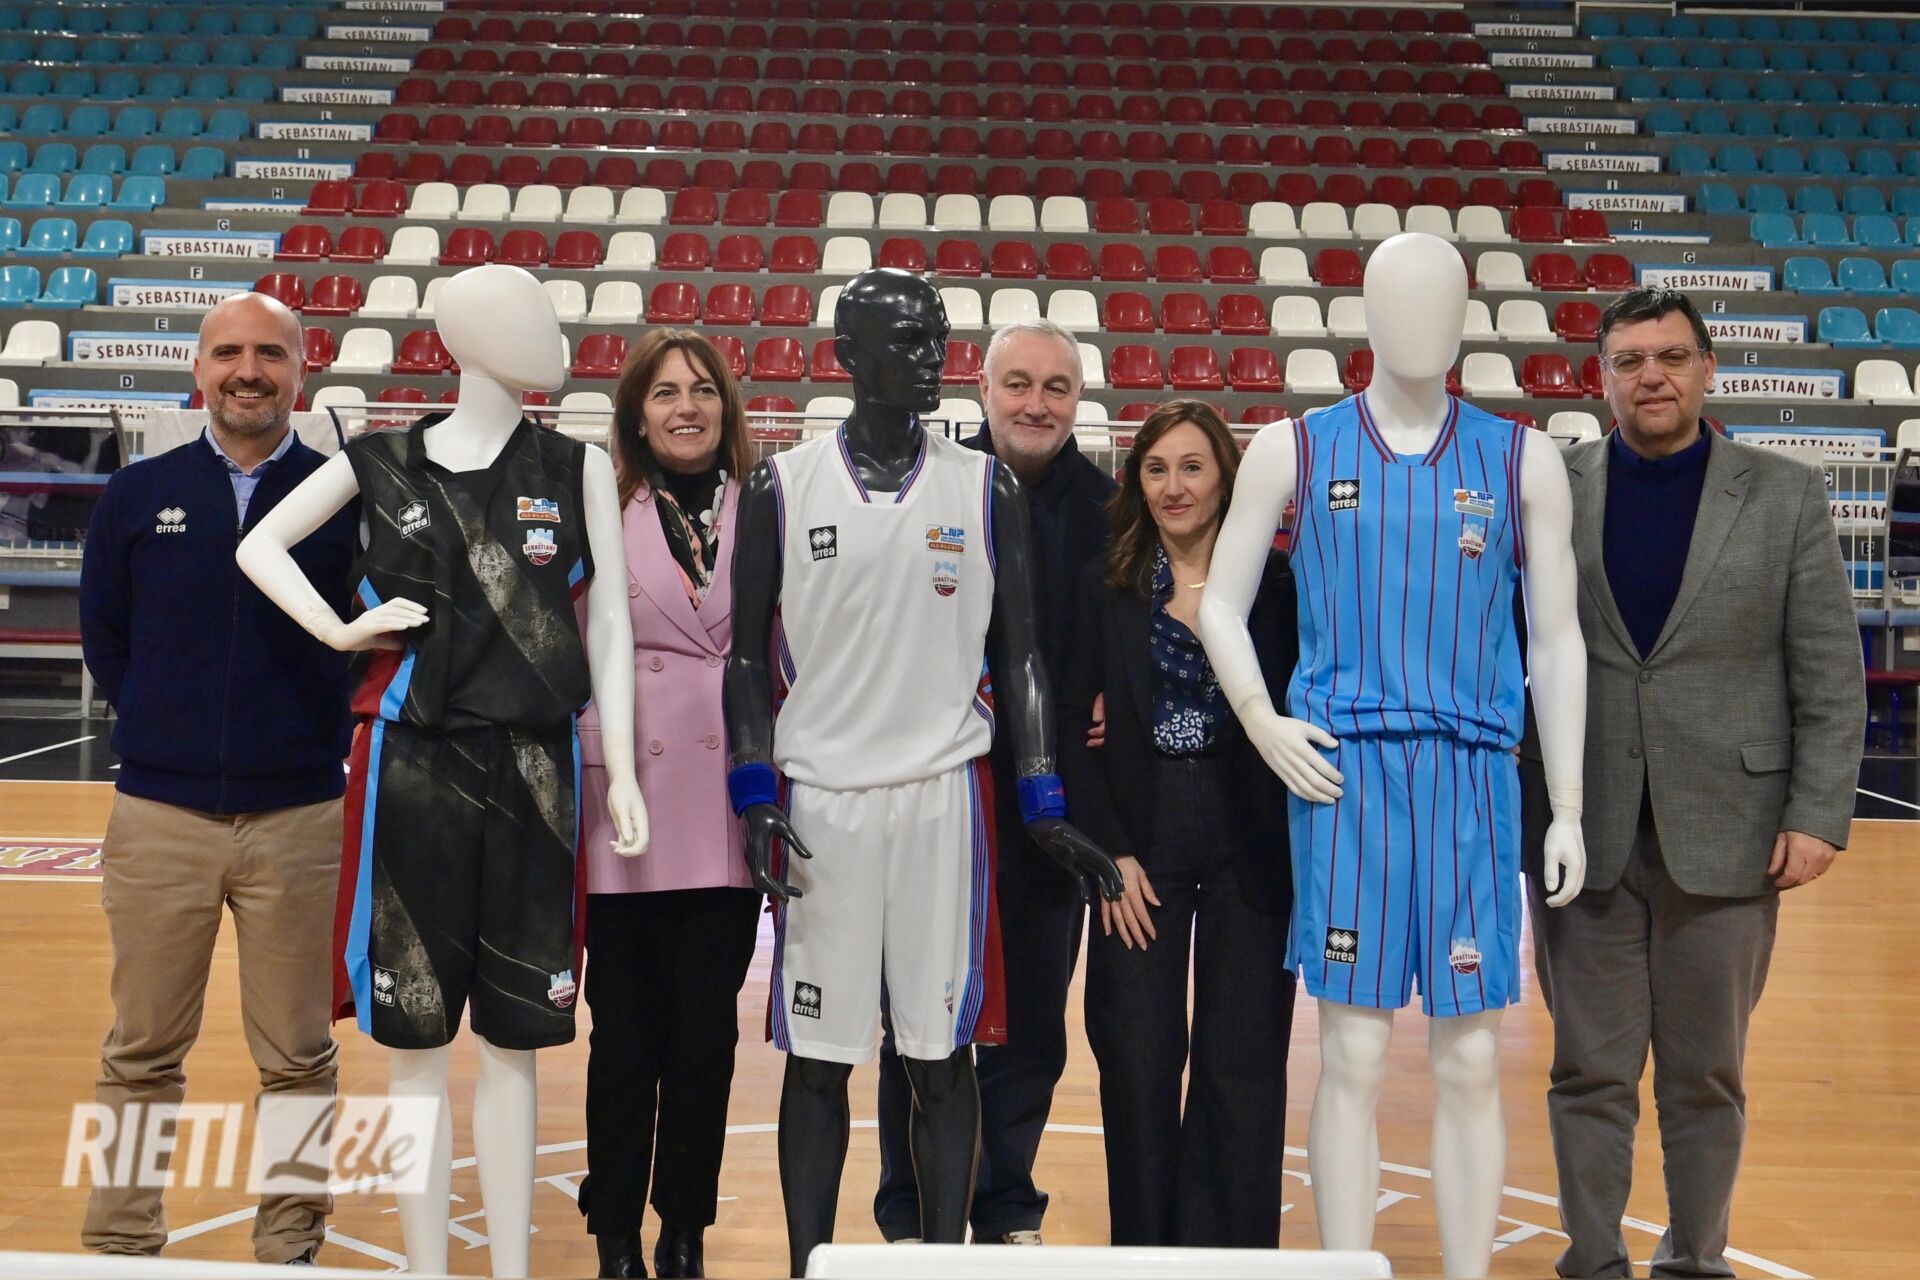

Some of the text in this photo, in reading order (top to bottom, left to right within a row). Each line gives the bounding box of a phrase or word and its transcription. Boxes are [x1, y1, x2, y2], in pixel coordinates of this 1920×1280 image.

[345, 30, 411, 40] SEBASTIANI
[323, 60, 392, 72] SEBASTIANI
[301, 92, 372, 104] SEBASTIANI
[1527, 89, 1596, 100] SEBASTIANI
[278, 127, 352, 140] SEBASTIANI
[1546, 122, 1617, 134] SEBASTIANI
[1567, 159, 1640, 172] SEBASTIANI
[255, 165, 331, 179] SEBASTIANI
[273, 189, 282, 198] H
[1588, 198, 1664, 213] SEBASTIANI
[219, 220, 229, 229] G
[1631, 220, 1640, 229] H
[167, 242, 251, 257] SEBASTIANI
[1685, 253, 1694, 263] G
[194, 268, 200, 278] F
[1663, 275, 1748, 290] SEBASTIANI
[136, 290, 225, 305] SEBASTIAN
[1715, 302, 1724, 312] F
[158, 319, 166, 329] E
[1709, 325, 1780, 341] BASTIANI
[96, 343, 189, 361] SEBASTIANI
[1746, 353, 1756, 364] E
[122, 376, 132, 387] D
[1722, 379, 1815, 396] SEBASTIANI
[1782, 410, 1793, 422] D
[1329, 499, 1357, 509] errea
[156, 523, 186, 534] errea
[402, 518, 428, 535] errea
[813, 547, 836, 559] errea
[1326, 950, 1356, 962] errea
[793, 1003, 819, 1018] errea
